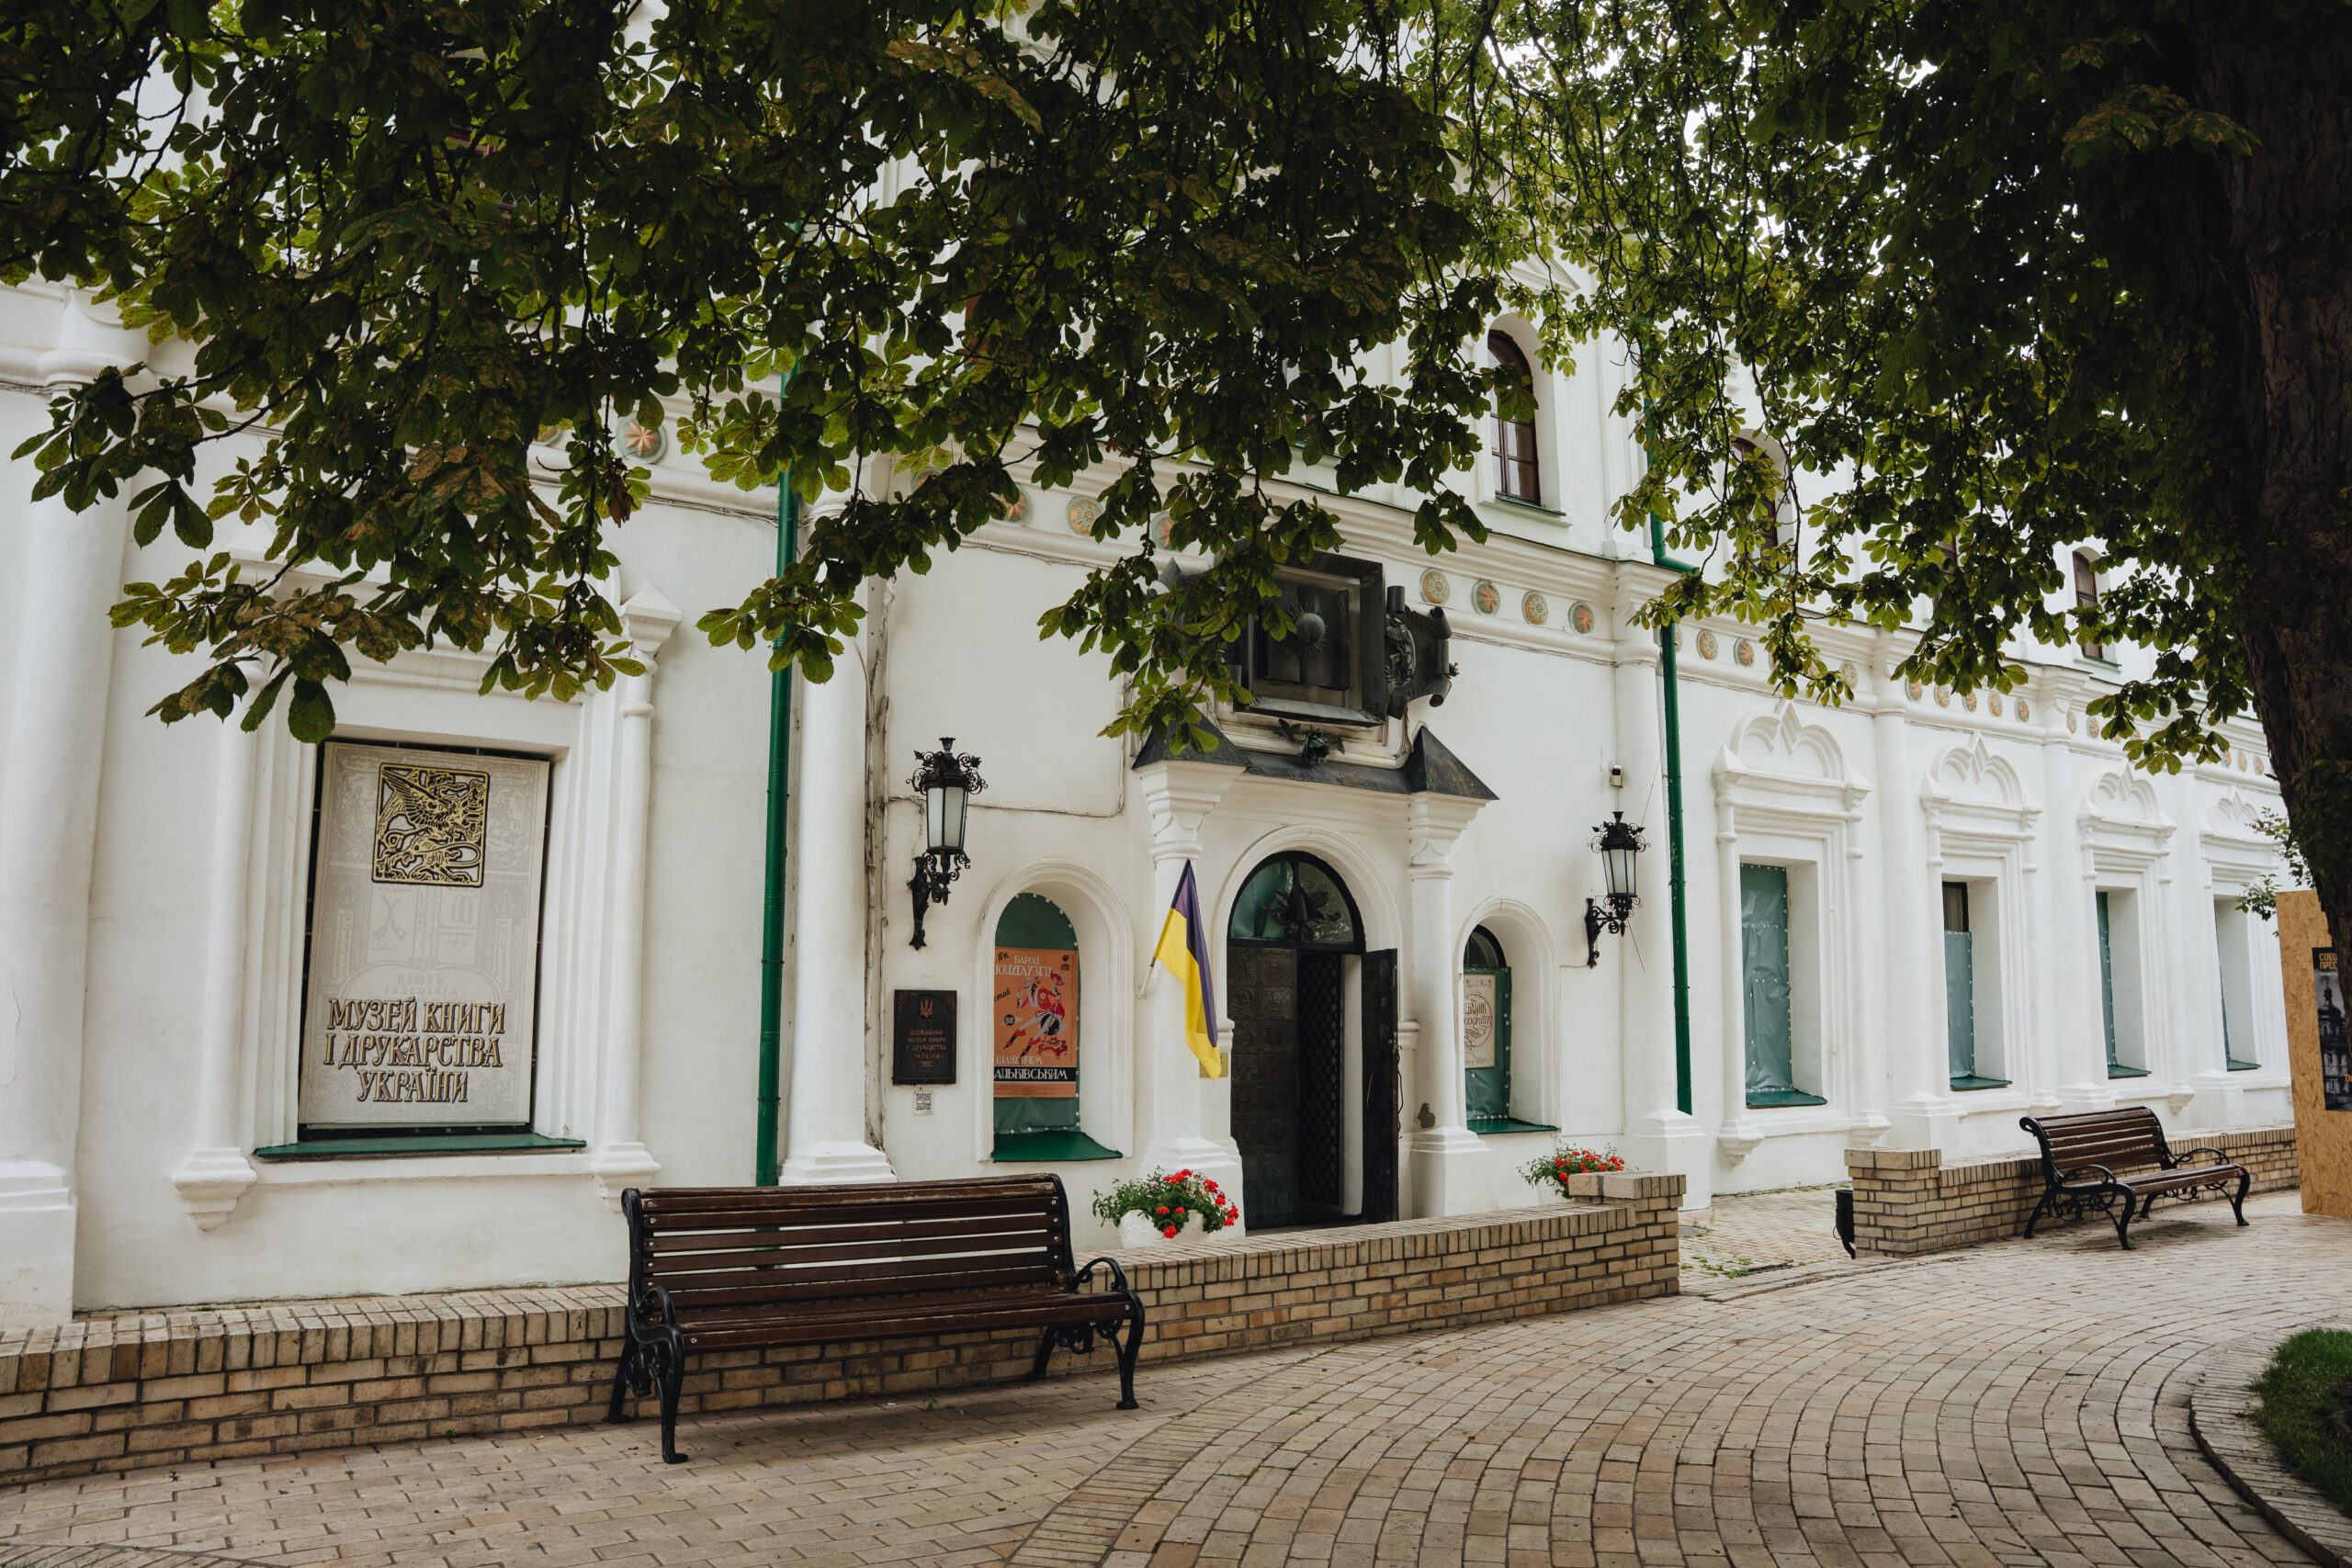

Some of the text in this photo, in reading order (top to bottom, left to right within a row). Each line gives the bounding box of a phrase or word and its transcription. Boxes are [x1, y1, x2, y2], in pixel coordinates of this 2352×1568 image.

[994, 964, 1053, 977] ЮНХГАУЗЕН
[1013, 955, 1040, 965] БАРОН
[326, 996, 505, 1035] МУЗЕЙ КНИГИ
[323, 1032, 503, 1070] І ДРУКАРСТВА
[356, 1065, 469, 1103] УКРАЇНИ
[993, 1067, 1069, 1079] АНЬКІВСЬКИМ
